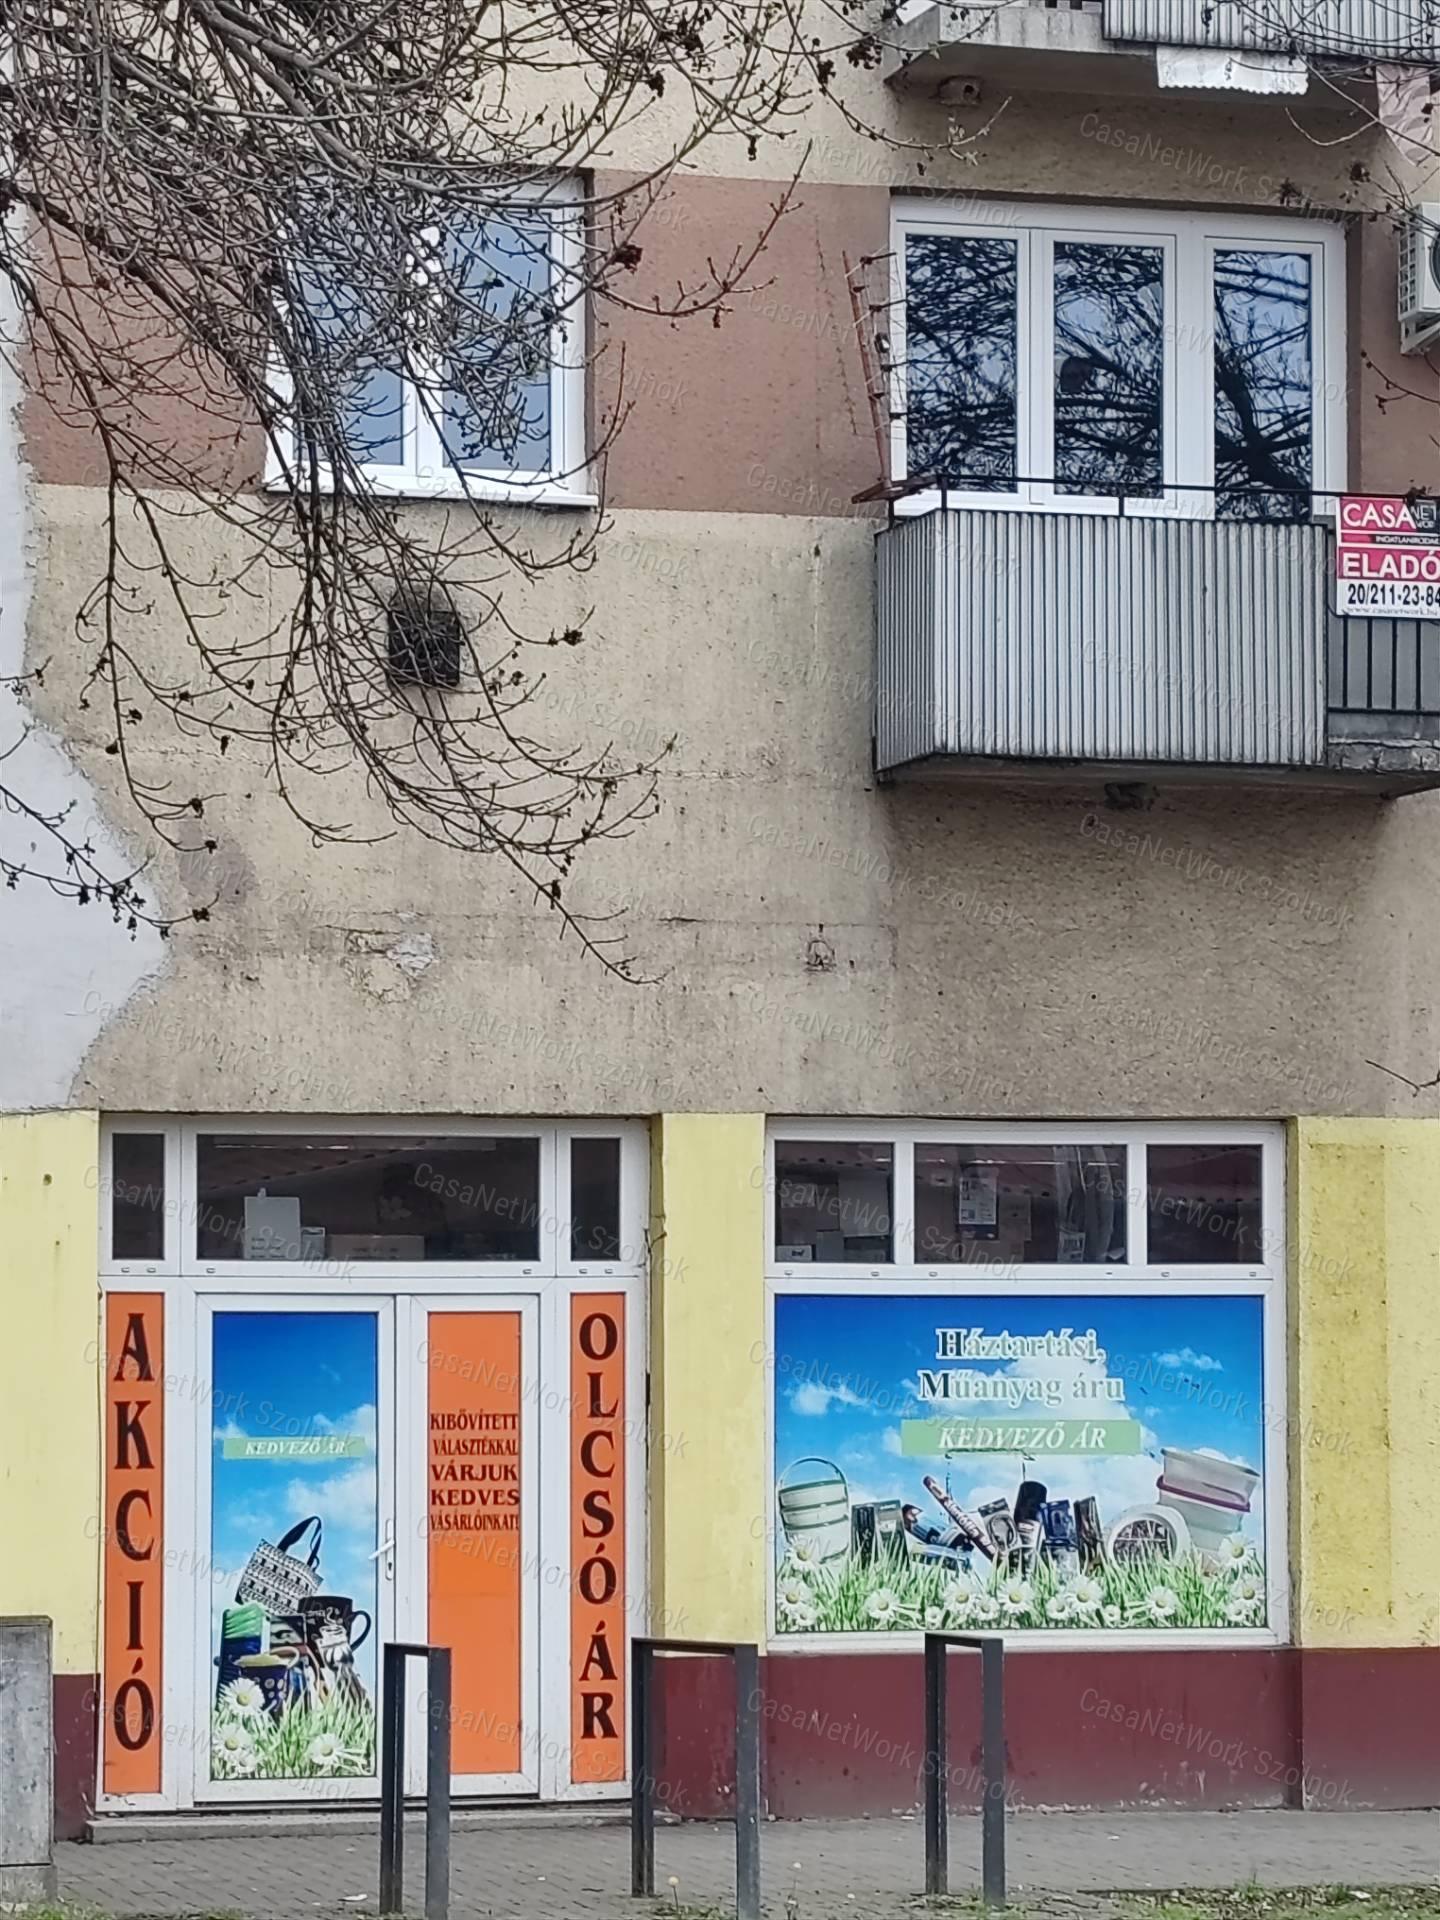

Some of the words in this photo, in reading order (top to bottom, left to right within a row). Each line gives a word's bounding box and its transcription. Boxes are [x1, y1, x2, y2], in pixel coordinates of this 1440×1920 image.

[1343, 503, 1417, 529] CASA
[1342, 549, 1440, 580] ELADÓ
[936, 1328, 1106, 1364] Háztartási,
[918, 1369, 1062, 1408] Műanyag
[1071, 1371, 1125, 1401] áru
[433, 1434, 519, 1456] VÁLASZTÉKKAL
[939, 1420, 1066, 1450] KEDVEZŐ
[1070, 1421, 1107, 1449] ÁR
[431, 1460, 518, 1481] VÁRJUK
[579, 1312, 619, 1606] OLCSÓ
[431, 1489, 521, 1506] KEDVES
[113, 1312, 155, 1751] AKCIÓ
[430, 1509, 519, 1531] VÁSÁRLÓINKAT!
[579, 1620, 619, 1740] ÁR
